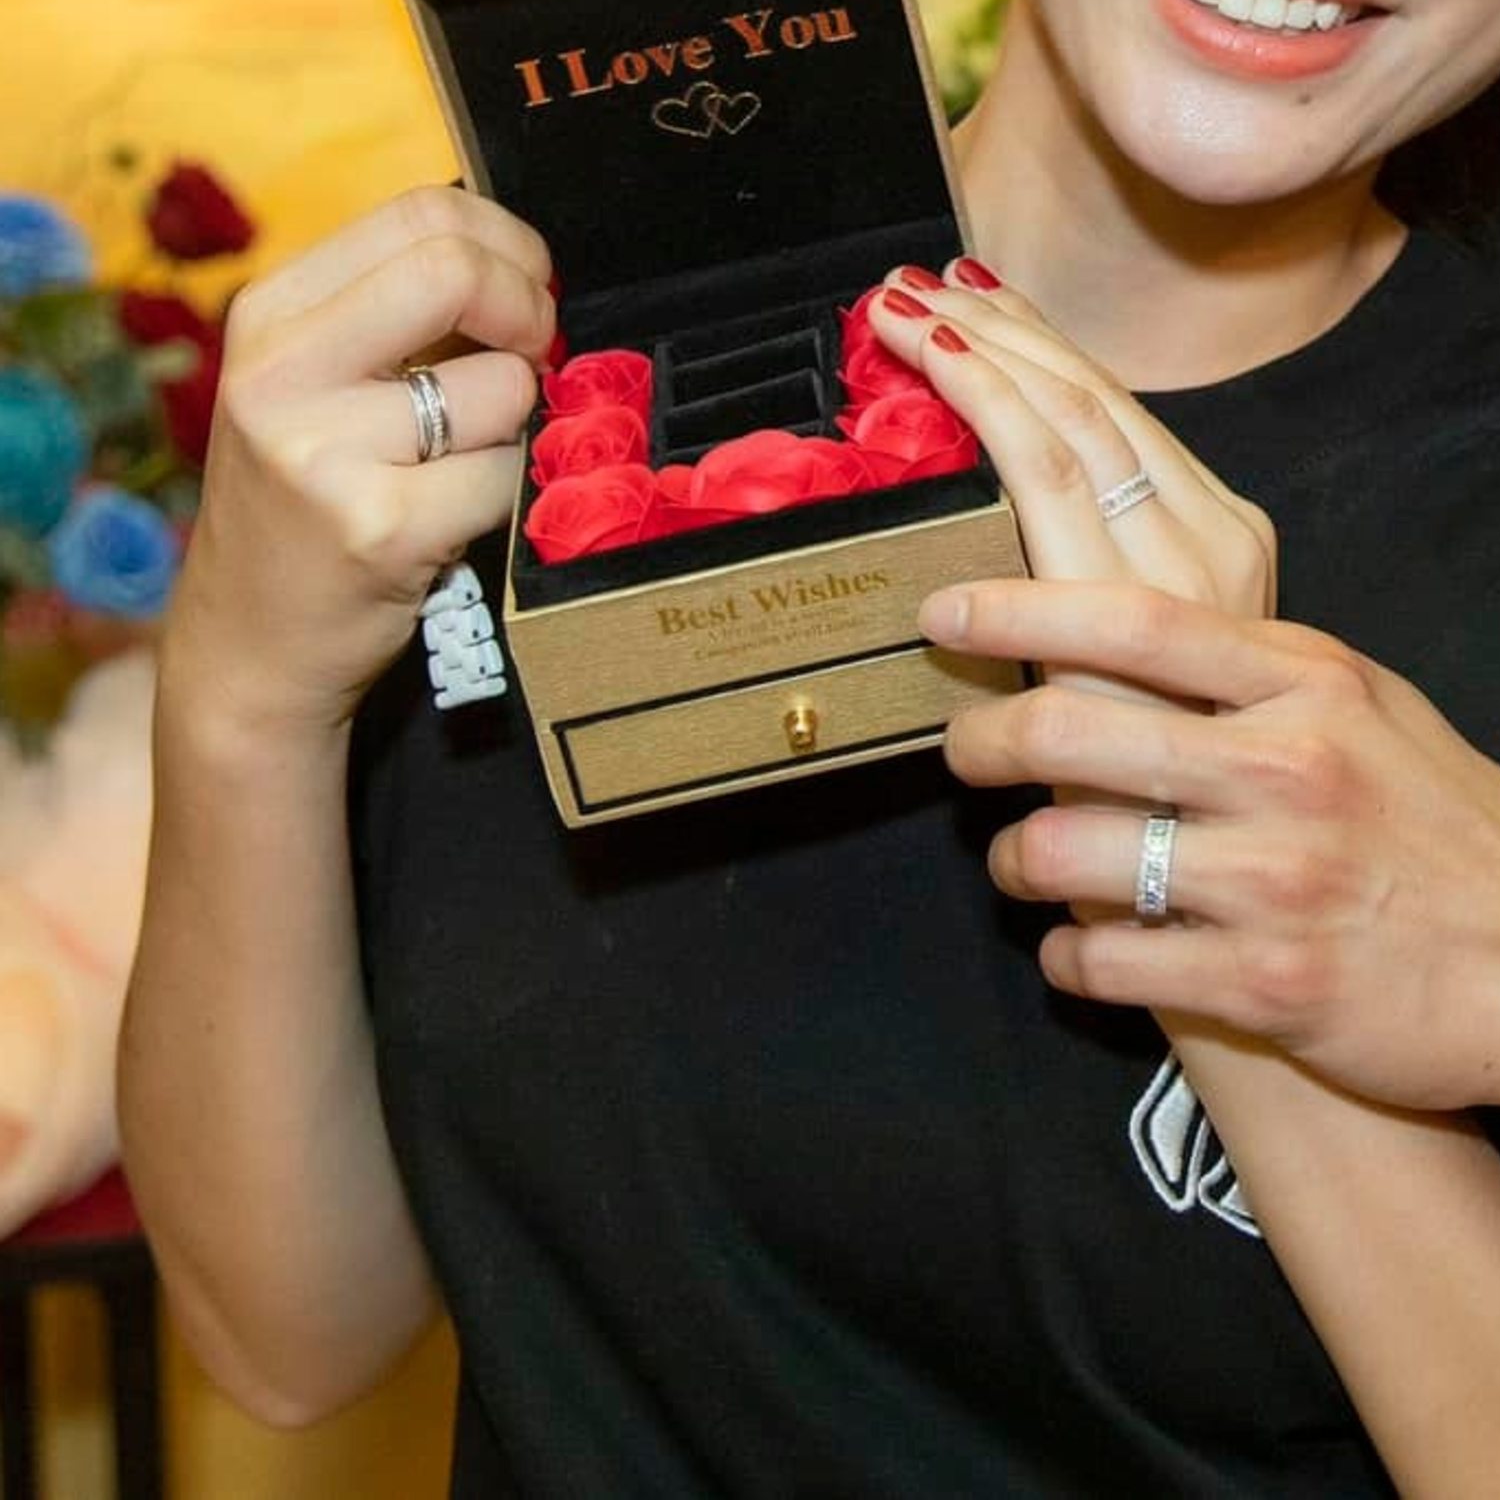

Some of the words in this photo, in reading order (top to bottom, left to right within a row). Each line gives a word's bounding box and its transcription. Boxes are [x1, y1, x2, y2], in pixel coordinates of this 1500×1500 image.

[514, 57, 552, 108] I
[557, 34, 717, 98] Love
[722, 7, 858, 59] You
[655, 598, 743, 636] Best
[750, 567, 890, 613] Wishes
